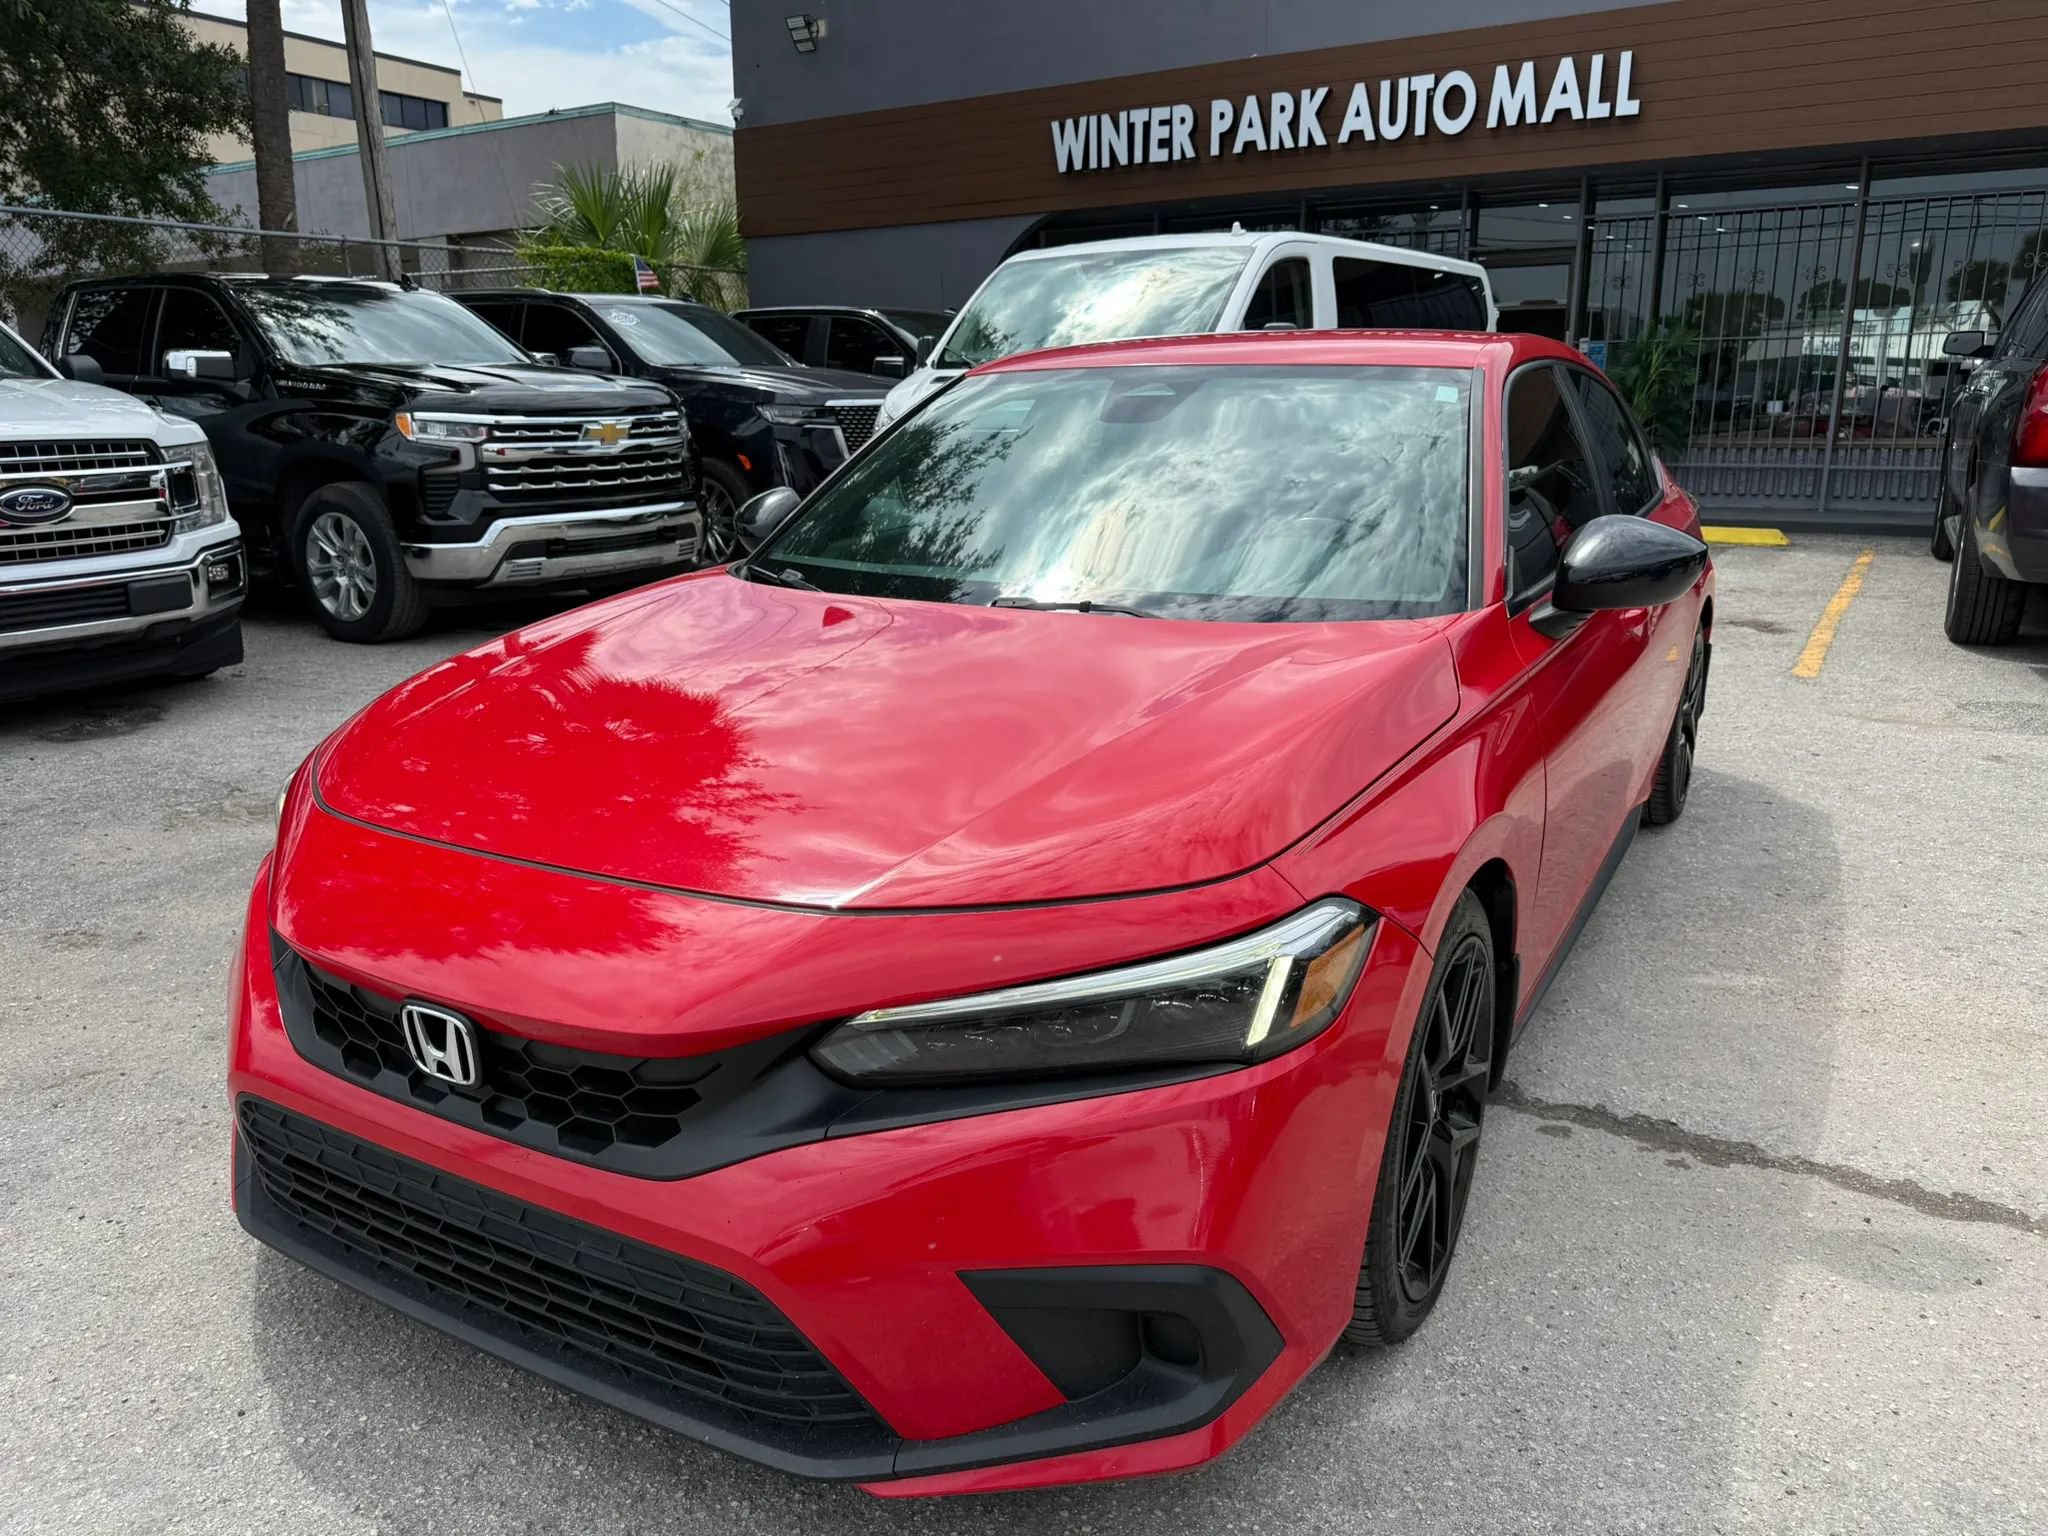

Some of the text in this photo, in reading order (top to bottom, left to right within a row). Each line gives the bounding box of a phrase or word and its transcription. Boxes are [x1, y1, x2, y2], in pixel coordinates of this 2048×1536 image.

[1051, 50, 1641, 173] WINTER PARK AUTO MALL
[15, 494, 54, 511] Ford
